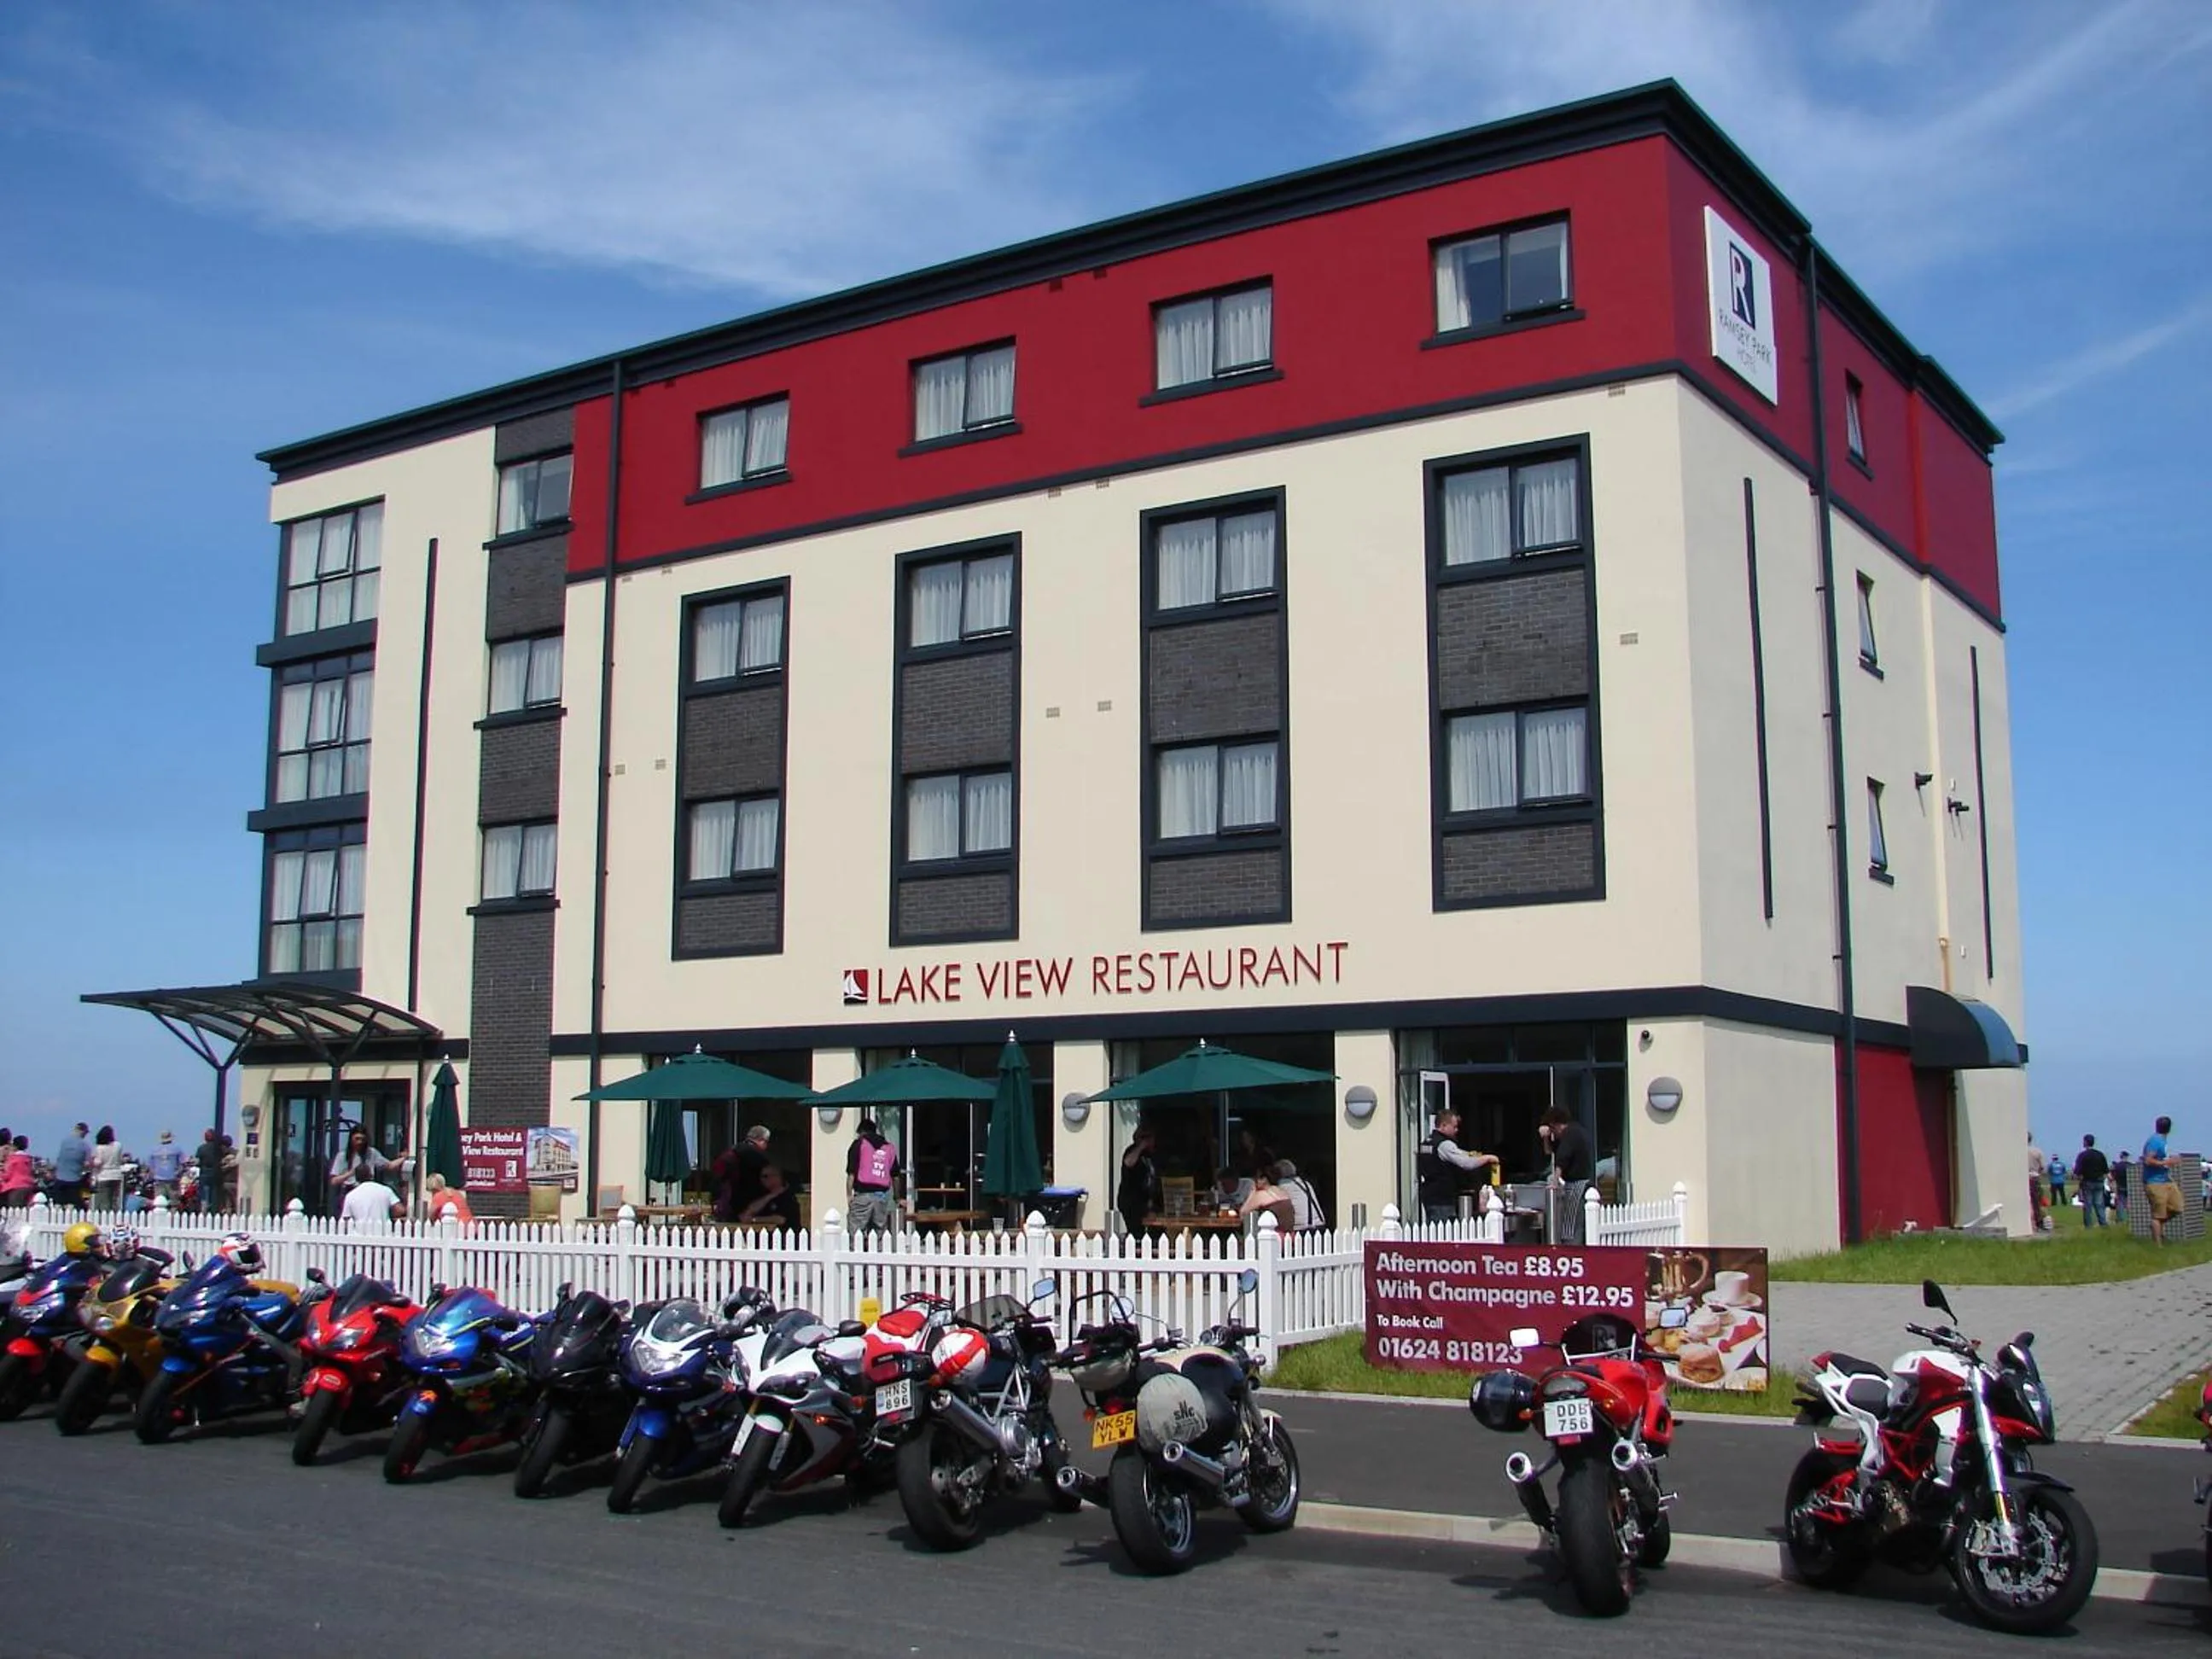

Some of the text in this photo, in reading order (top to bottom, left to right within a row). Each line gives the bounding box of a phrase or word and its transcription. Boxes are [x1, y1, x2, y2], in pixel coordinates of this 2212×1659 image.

[877, 941, 1349, 1005] LAKE VIEW RESTAURANT
[1376, 1252, 1585, 1278] Afternoon Tea £8.95
[1377, 1278, 1633, 1308] With Champagne £12.95
[1377, 1314, 1444, 1330] To Book Call
[1378, 1337, 1523, 1364] 01624 818123
[1558, 1417, 1588, 1432] 756
